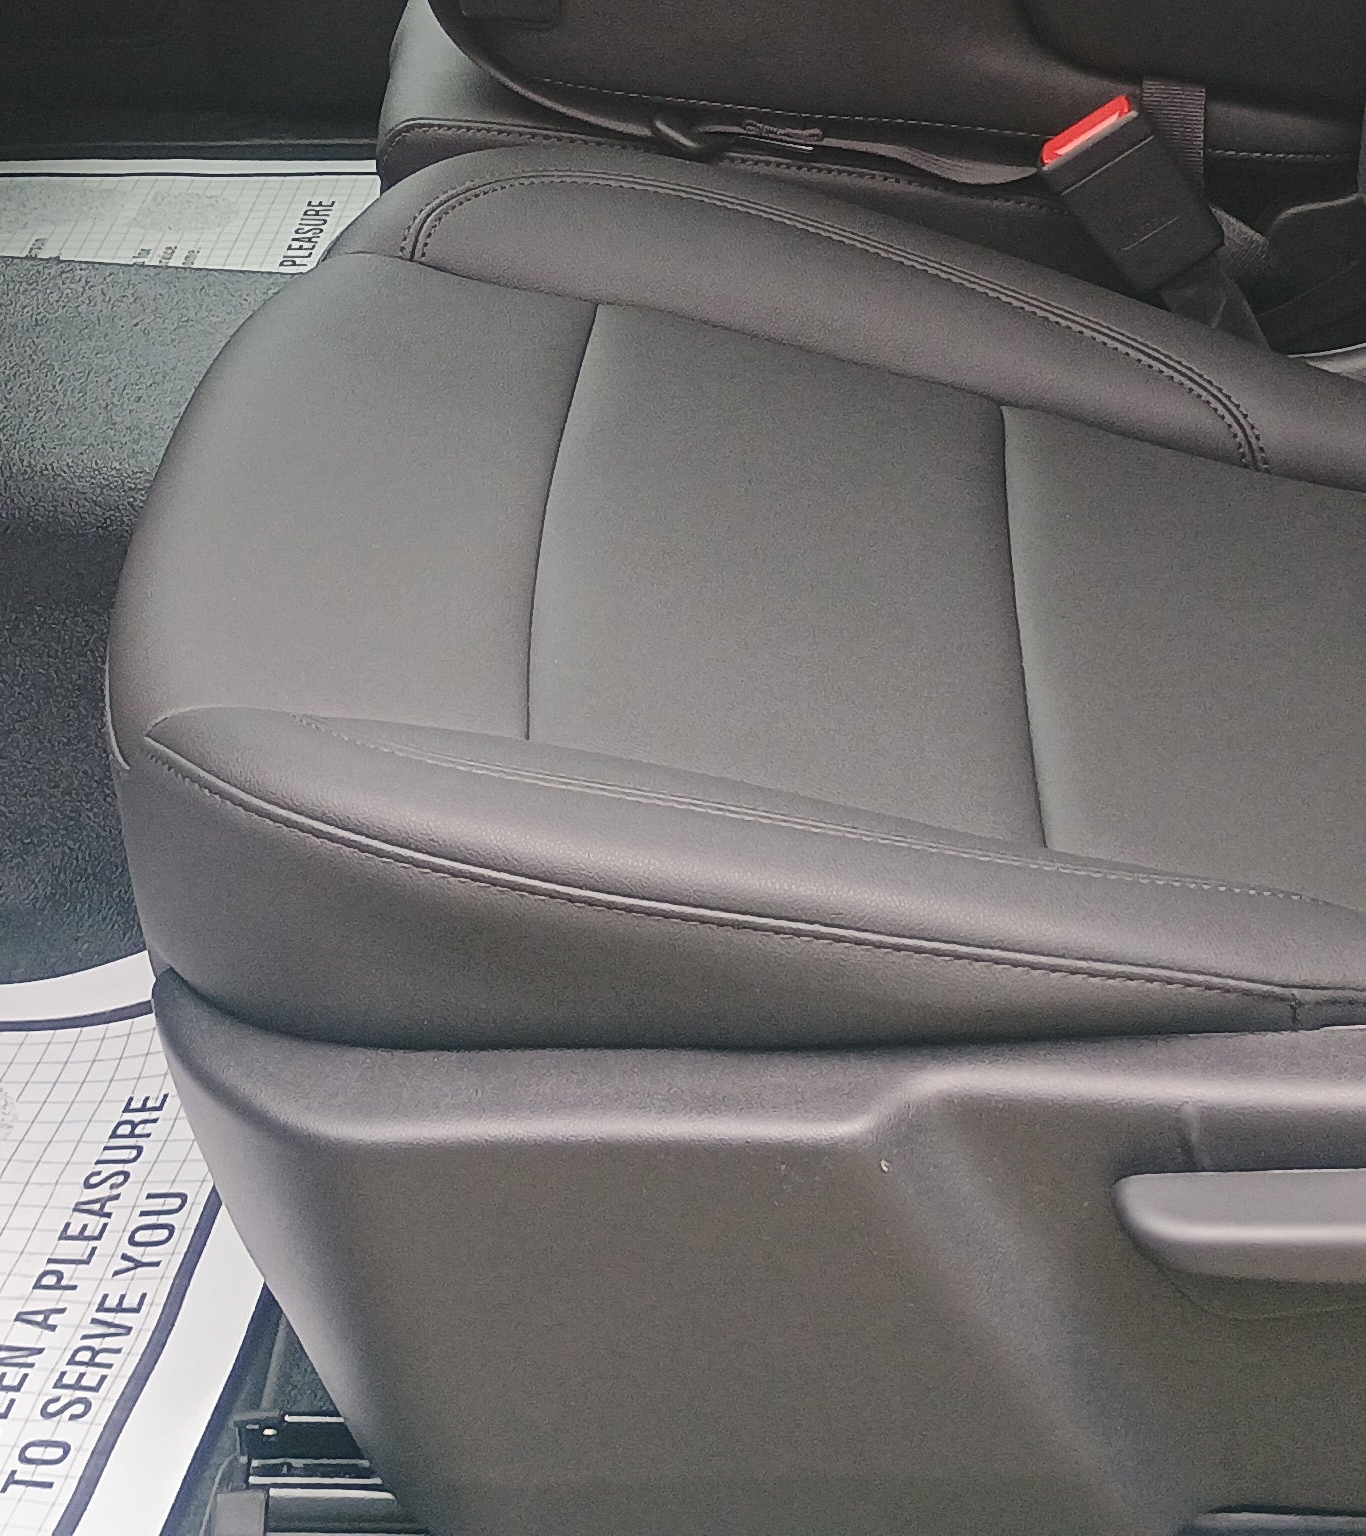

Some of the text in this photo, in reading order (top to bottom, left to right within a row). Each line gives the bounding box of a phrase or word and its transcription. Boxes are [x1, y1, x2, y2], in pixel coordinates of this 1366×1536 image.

[278, 200, 336, 267] PLEASURE
[31, 1092, 169, 1291] PLEASURE
[0, 1191, 189, 1494] TO SERVE YOU
[13, 1306, 68, 1333] A
